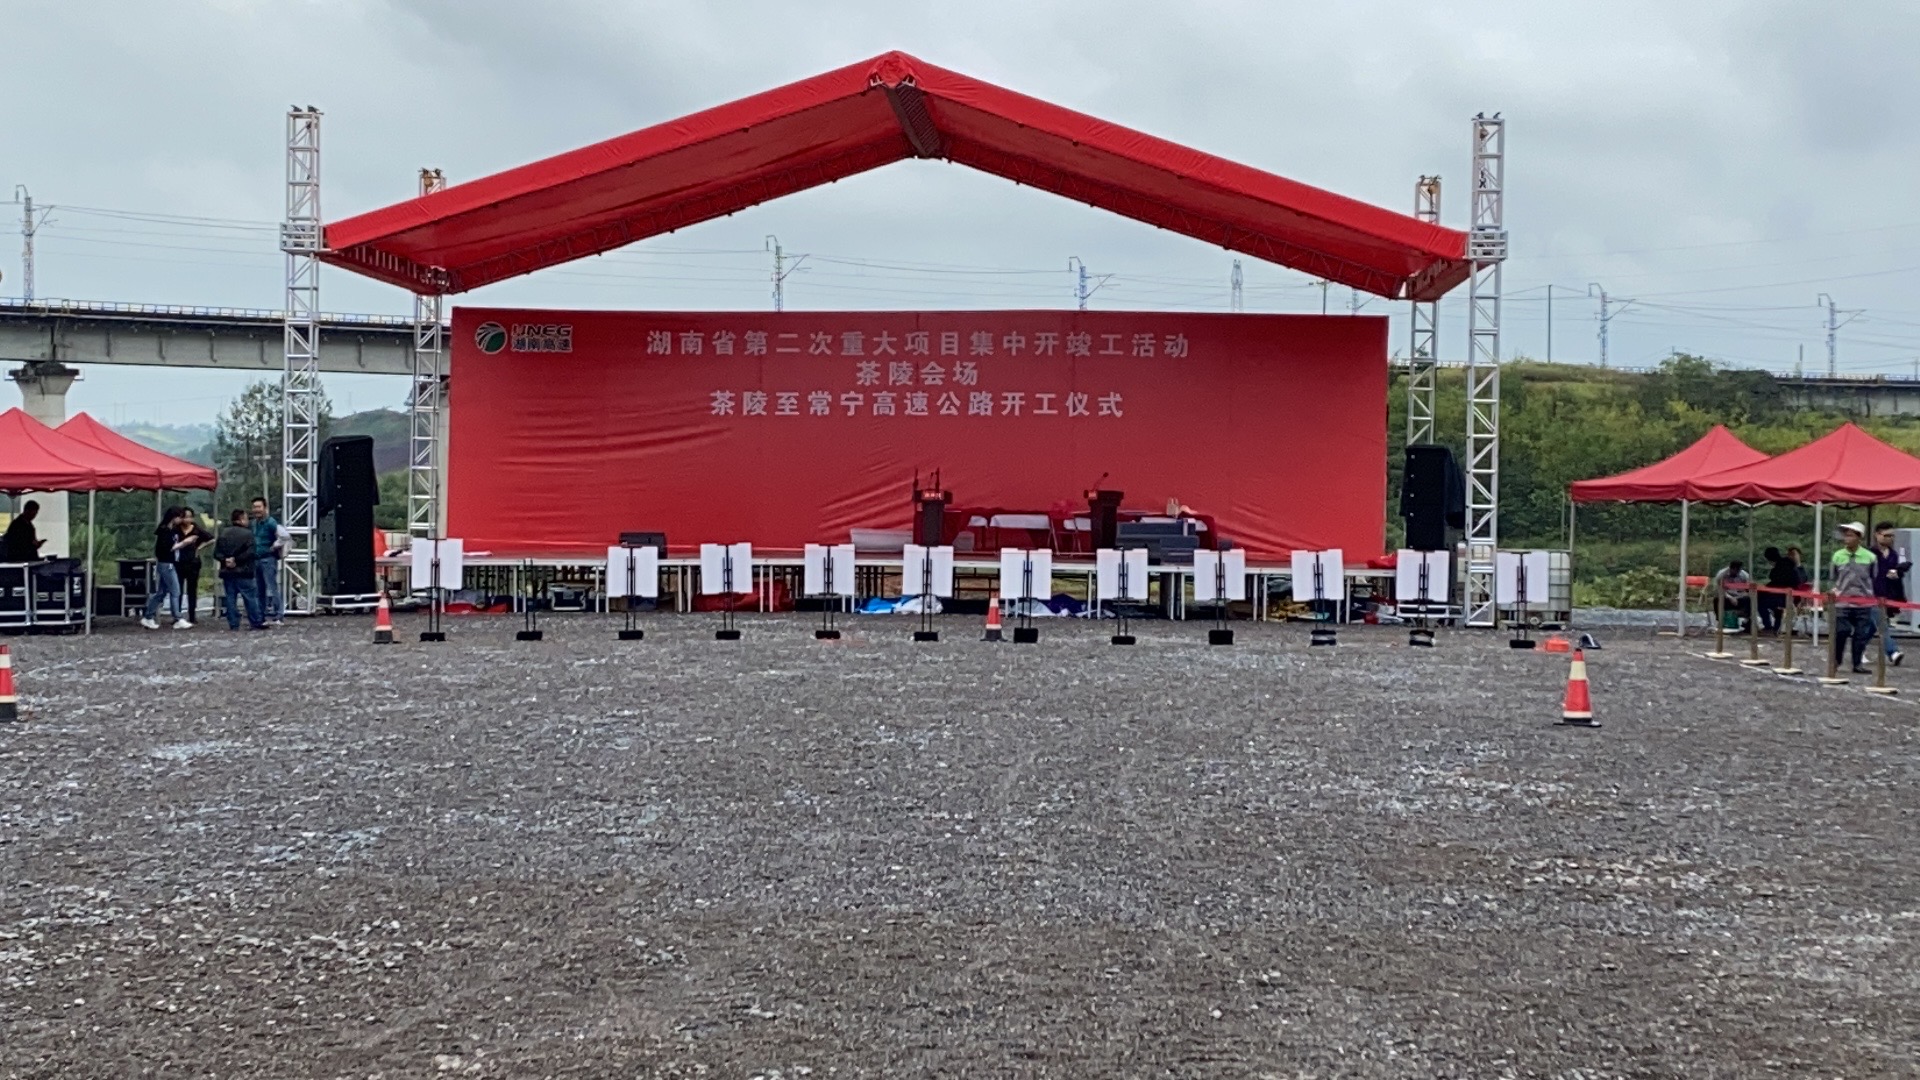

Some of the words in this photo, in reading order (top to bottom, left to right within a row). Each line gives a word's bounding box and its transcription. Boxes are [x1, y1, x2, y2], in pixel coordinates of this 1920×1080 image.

[646, 331, 1189, 357] 湖南省第二次重大项目集中开竣工活动
[855, 361, 979, 386] 茶陵会场
[709, 390, 1123, 417] 茶陵至常宁高速公路开工仪式
